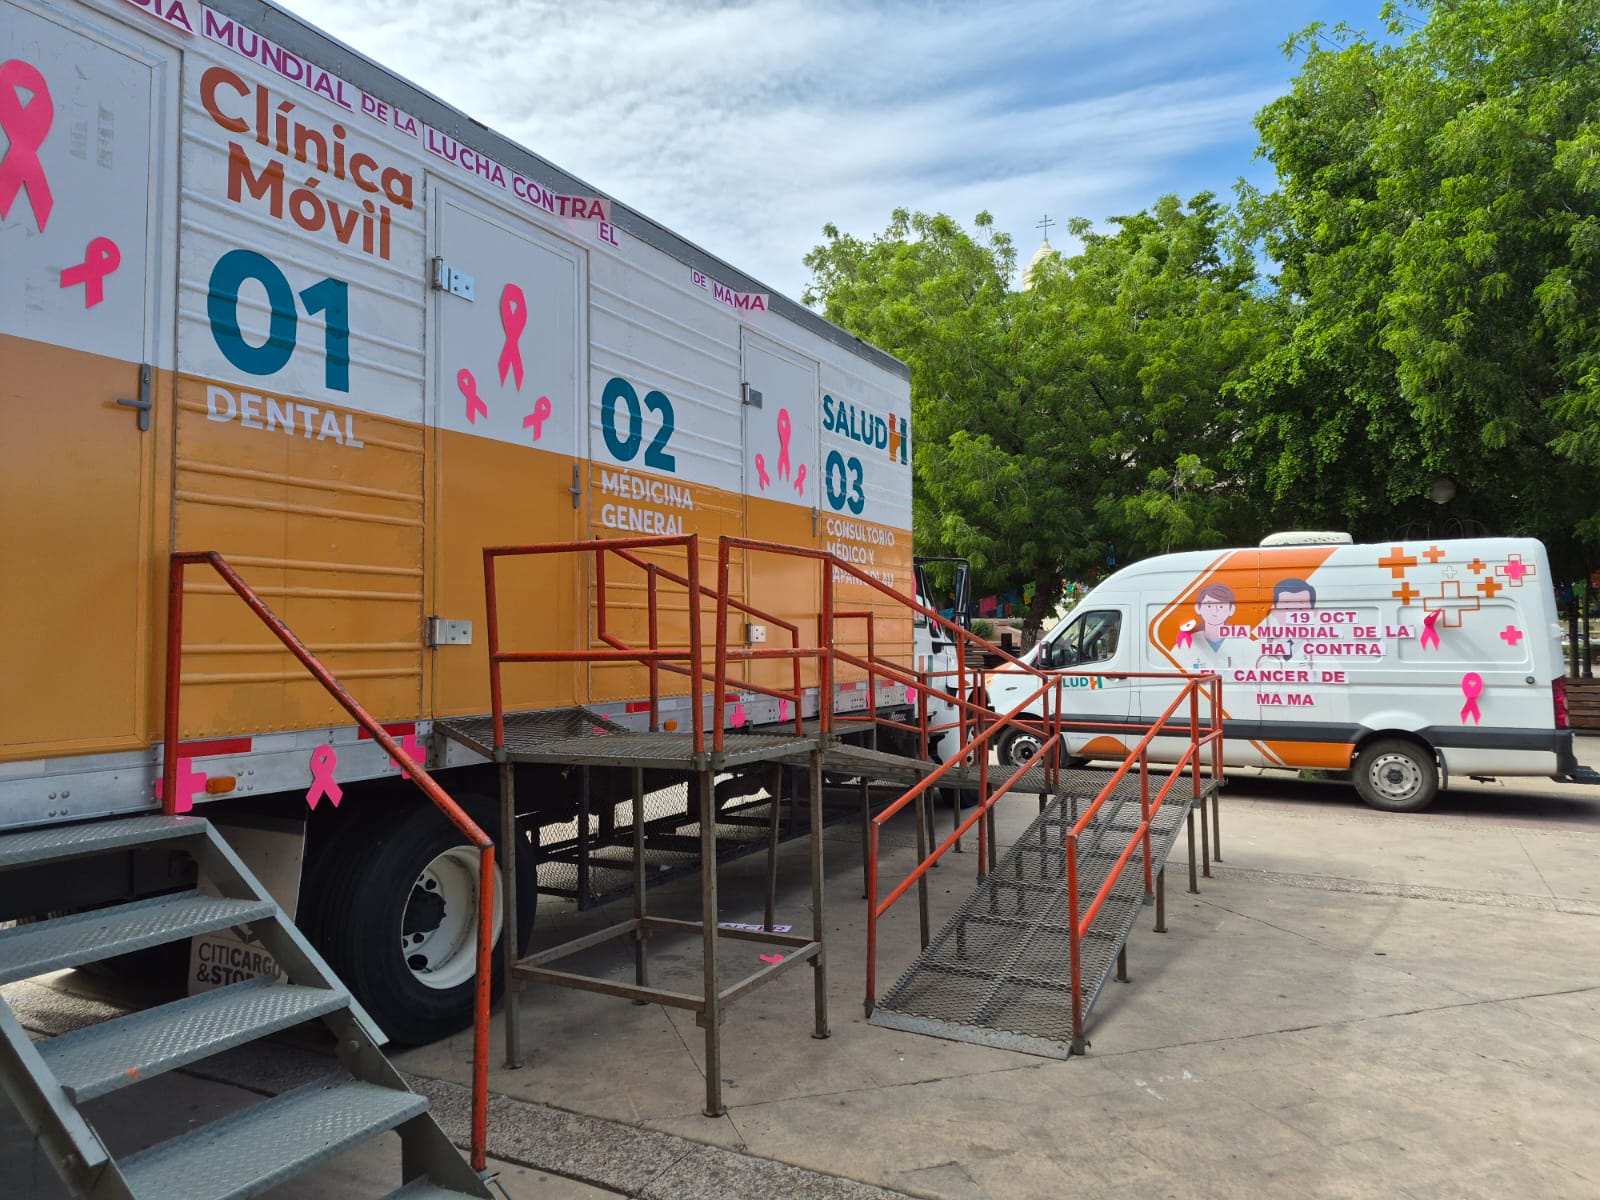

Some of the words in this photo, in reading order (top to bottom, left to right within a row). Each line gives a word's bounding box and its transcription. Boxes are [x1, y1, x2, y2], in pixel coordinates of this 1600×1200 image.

[131, 0, 194, 32] IA
[205, 9, 352, 109] MUNDIAL
[361, 93, 388, 122] DE
[394, 110, 418, 137] LA
[428, 129, 506, 188] LUCHA
[513, 176, 606, 221] CONTRA
[599, 222, 619, 246] EL
[693, 271, 706, 287] DE
[713, 283, 765, 311] MAMA
[200, 66, 413, 210] Clínica
[227, 141, 391, 261] Móvil
[207, 249, 350, 393] 01
[206, 385, 364, 448] DENTAL
[601, 377, 675, 472] 02
[601, 469, 694, 511] MÉDICINA
[826, 450, 865, 515] 03
[826, 518, 895, 547] CONSULTORIO
[826, 539, 867, 564] MÉDICO
[869, 547, 874, 566] Y
[1257, 626, 1339, 638] MUNDIAL
[1353, 626, 1377, 638] DE
[1386, 625, 1410, 638] LA
[1290, 612, 1310, 623] 19
[1320, 611, 1357, 624] OCT
[1261, 643, 1286, 655] HA
[1303, 643, 1382, 655] CONTRA
[1234, 669, 1309, 682] CANCER
[1321, 671, 1345, 683] DE
